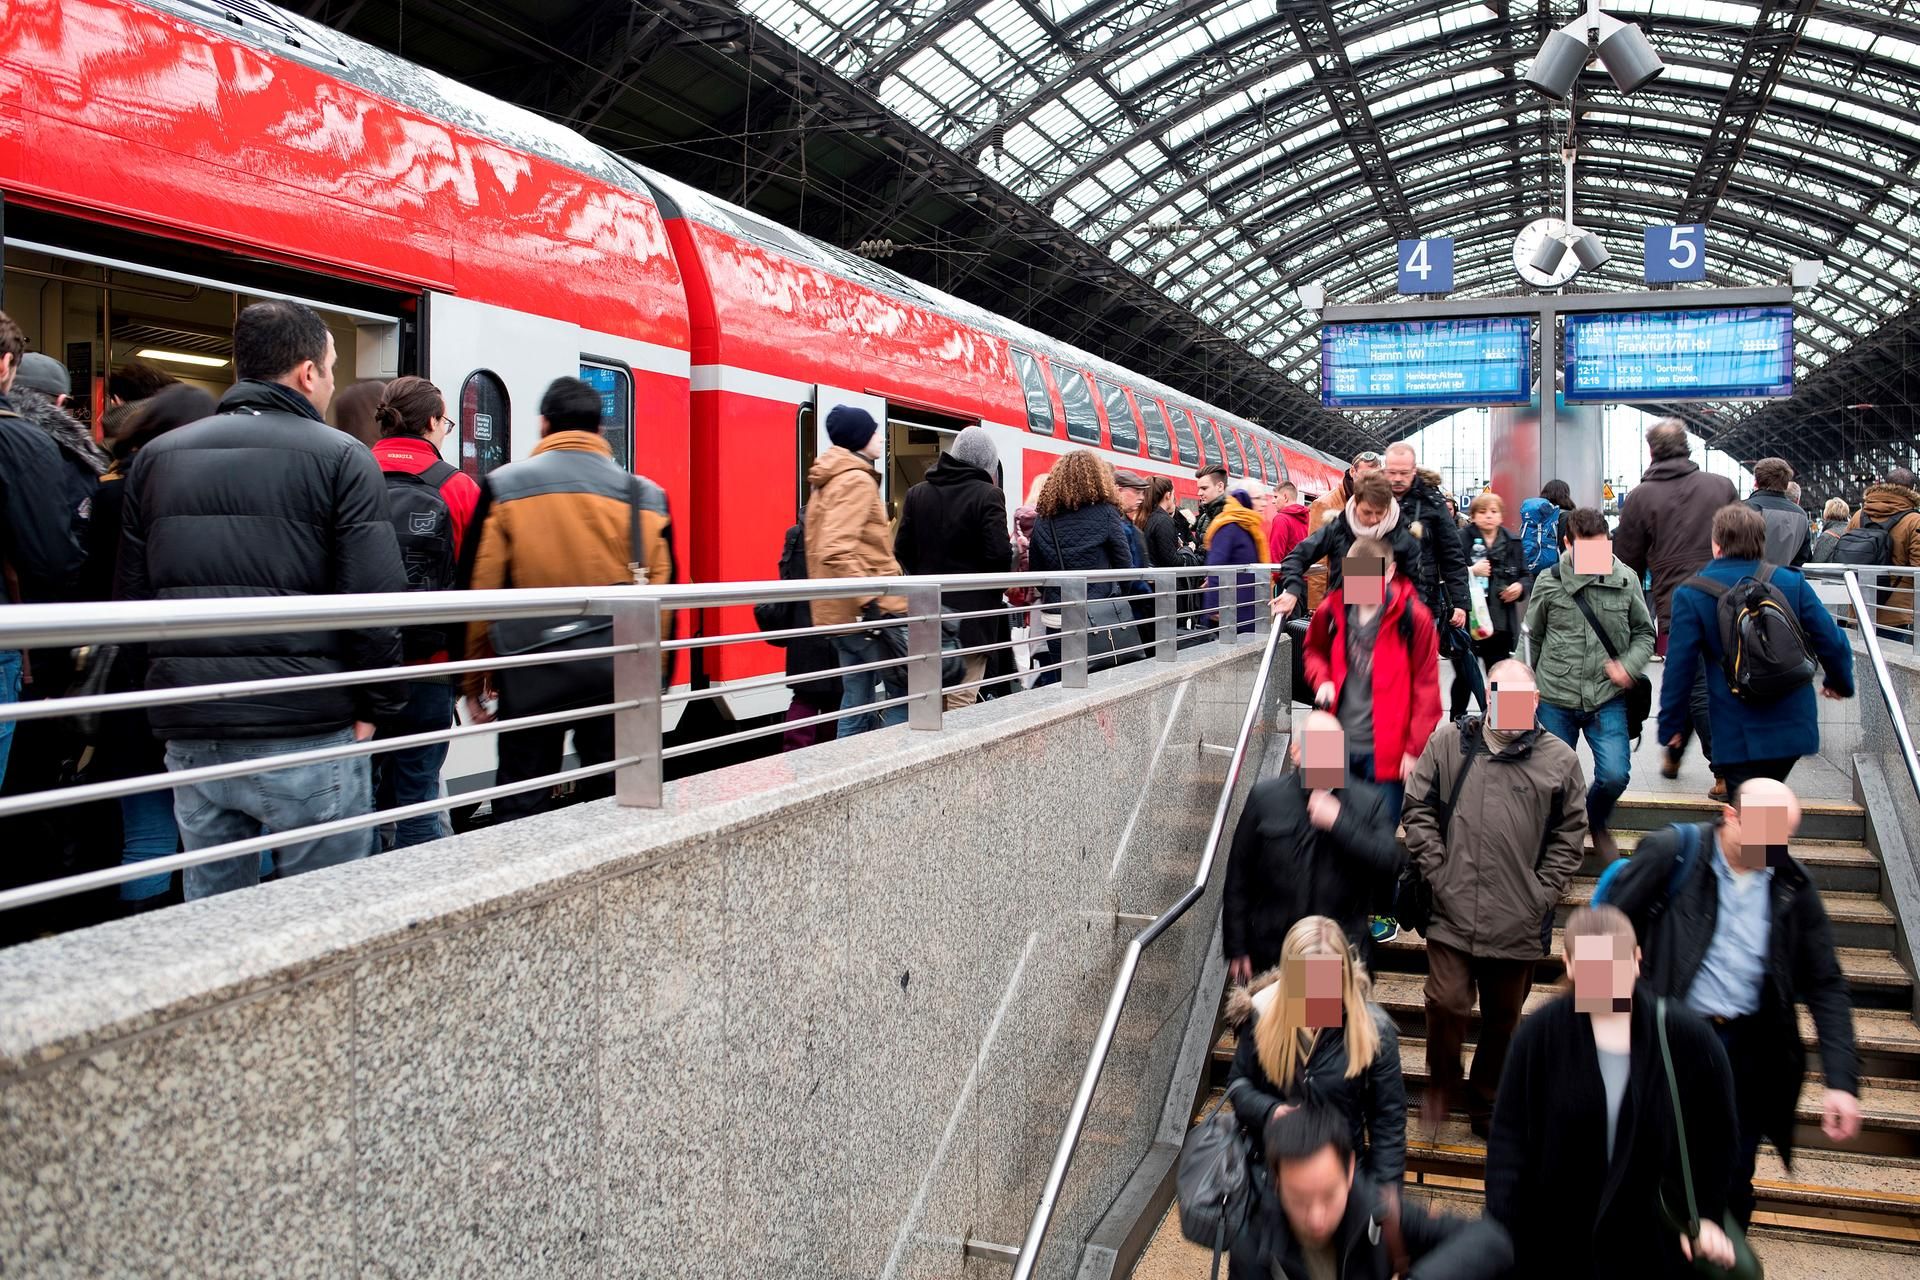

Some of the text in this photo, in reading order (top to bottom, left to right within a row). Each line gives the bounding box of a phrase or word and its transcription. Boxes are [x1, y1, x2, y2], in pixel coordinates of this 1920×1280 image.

[1667, 226, 1696, 269] 5
[1405, 240, 1432, 281] 4
[1579, 327, 1604, 338] 11:53
[1335, 337, 1359, 347] 11:49
[1617, 338, 1712, 352] Frankfurt/M Hbf
[1370, 349, 1425, 361] Hamm (W)
[1578, 366, 1600, 375] 12:11
[1656, 365, 1693, 373] Dortmund
[1335, 374, 1355, 383] 12:10
[1406, 371, 1463, 381] Hamburg-Altona
[1578, 376, 1600, 385] 12:15
[1672, 375, 1698, 383] Emden
[1406, 381, 1450, 390] Frankfurt/M
[1452, 381, 1465, 389] Hbf
[1461, 495, 1471, 508] D
